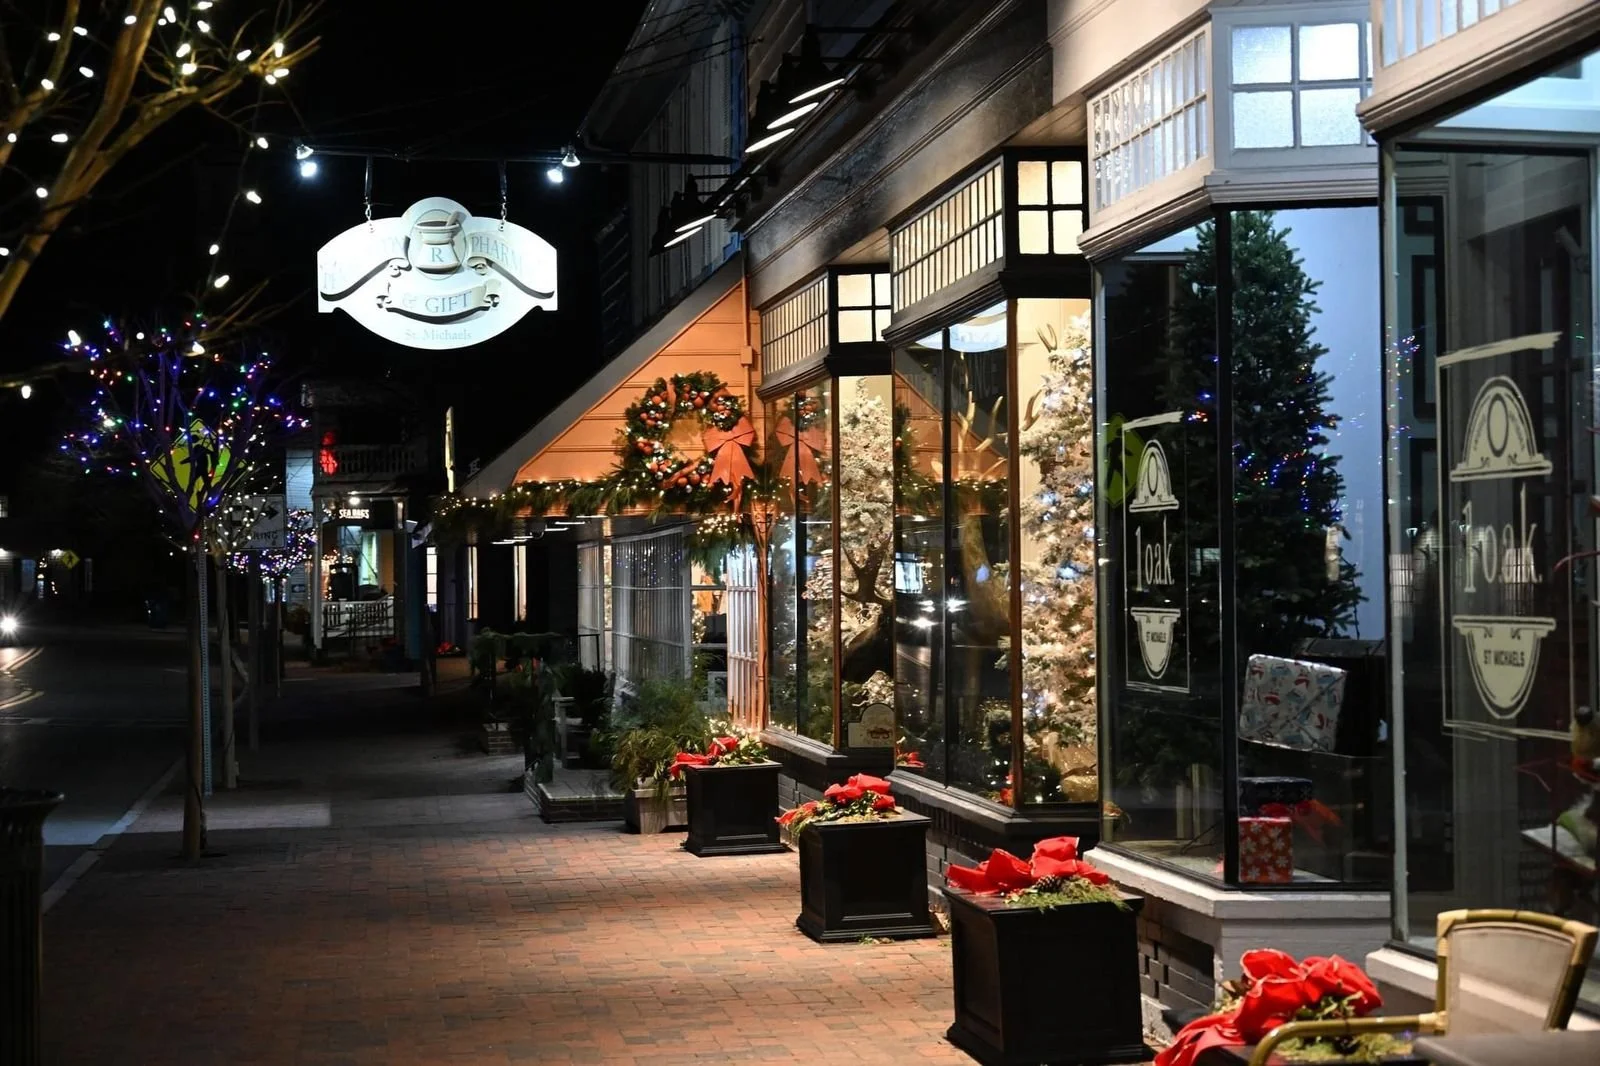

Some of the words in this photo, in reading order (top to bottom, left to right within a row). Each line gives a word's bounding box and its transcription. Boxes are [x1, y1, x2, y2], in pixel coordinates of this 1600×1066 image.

[430, 247, 445, 263] R
[471, 235, 523, 275] PHARM
[424, 292, 472, 314] GIFT
[421, 328, 472, 341] Michaels
[1483, 650, 1492, 664] ST
[1493, 650, 1525, 667] MICHAELS
